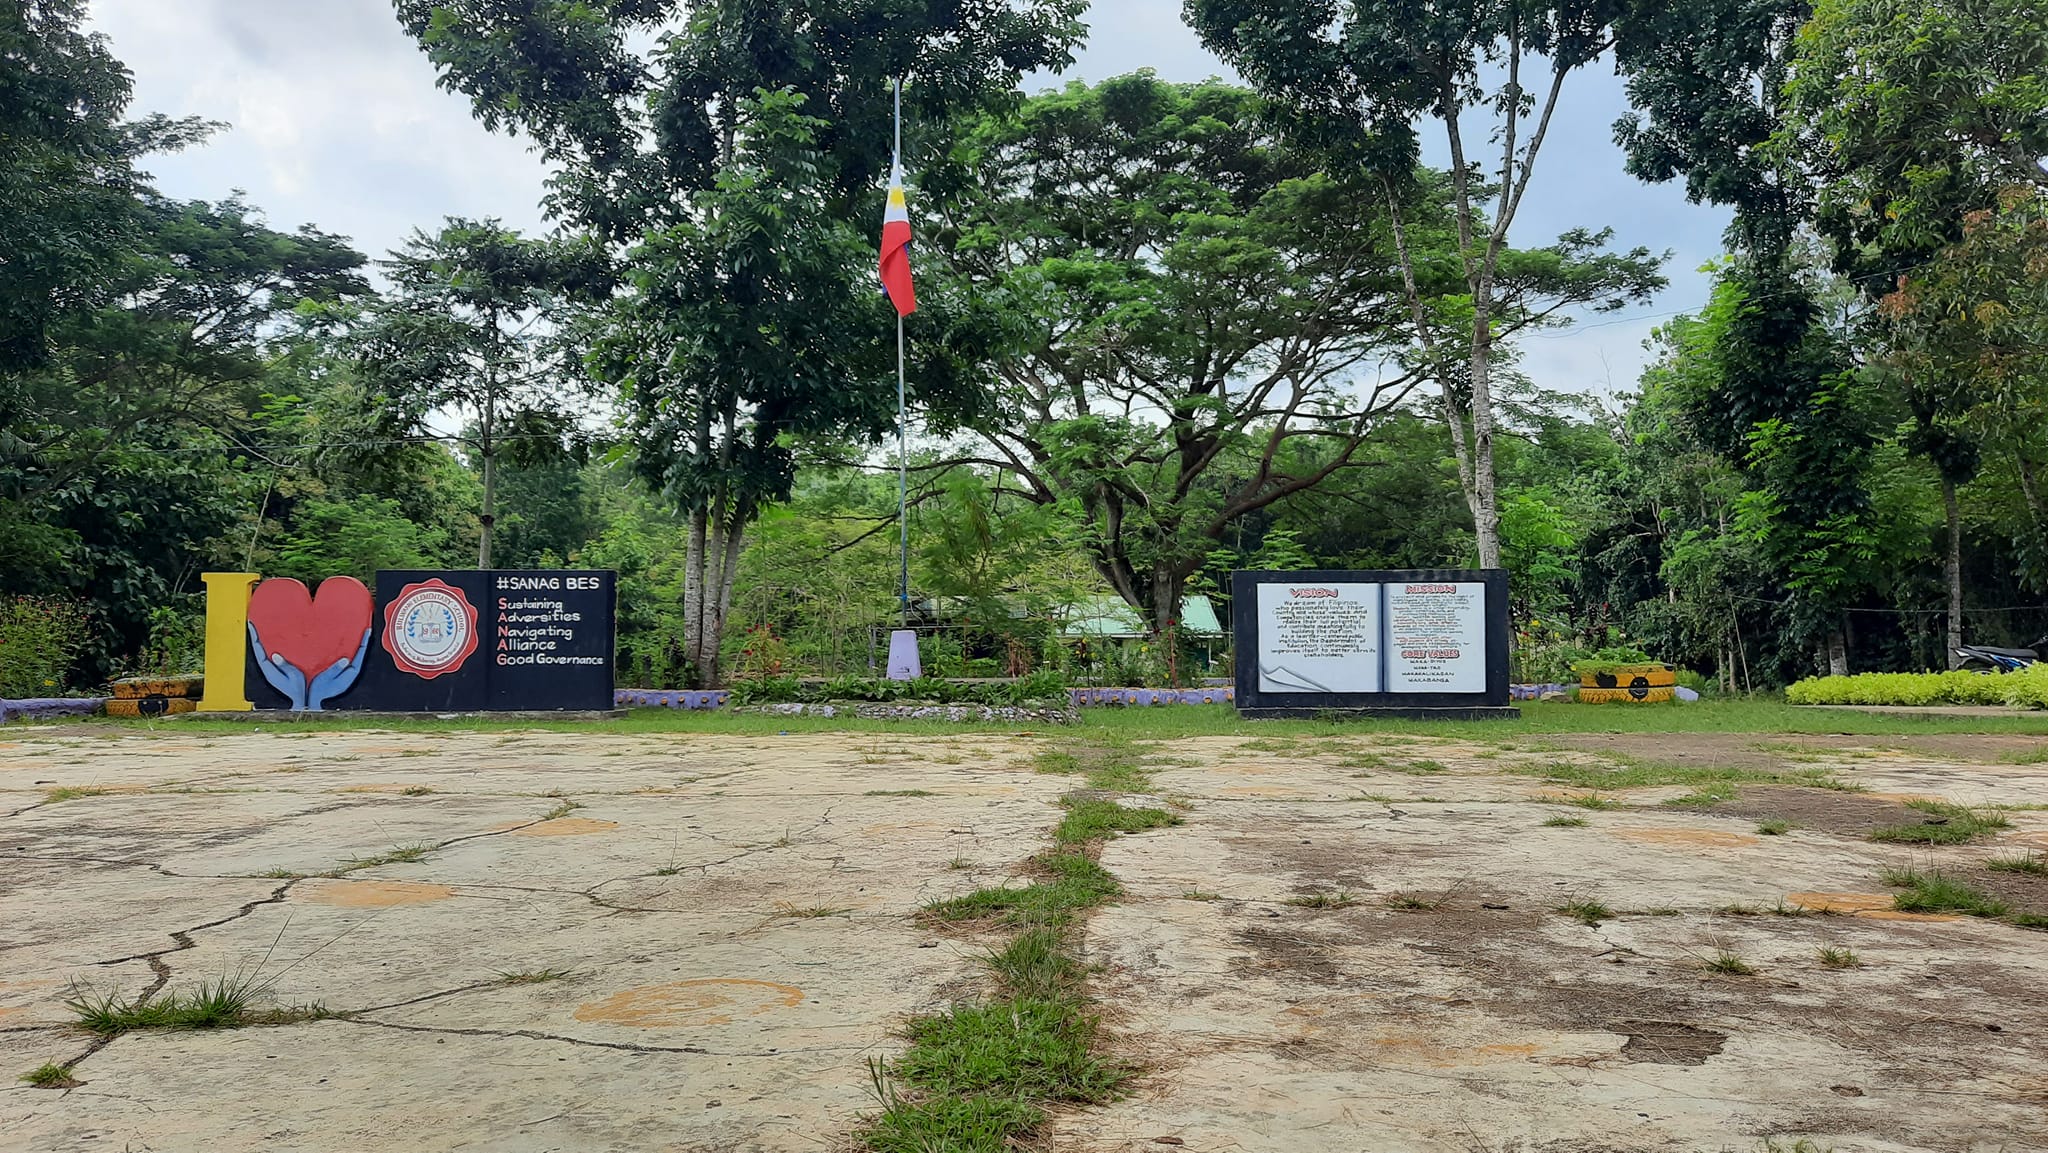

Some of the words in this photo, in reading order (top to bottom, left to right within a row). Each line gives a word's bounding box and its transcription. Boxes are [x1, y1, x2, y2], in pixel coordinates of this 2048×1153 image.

[496, 577, 559, 590] #SANAG
[566, 577, 599, 589] BES
[1405, 584, 1456, 594] MISSION
[1290, 588, 1339, 598] VISION
[498, 598, 563, 612] Sustaining
[498, 610, 580, 622] Adversities
[498, 626, 572, 640] Navigating
[497, 639, 556, 651] Alliance
[497, 653, 534, 665] Good
[536, 654, 604, 665] Governance
[1401, 650, 1426, 659] CORE
[1428, 649, 1460, 659] VALUES
